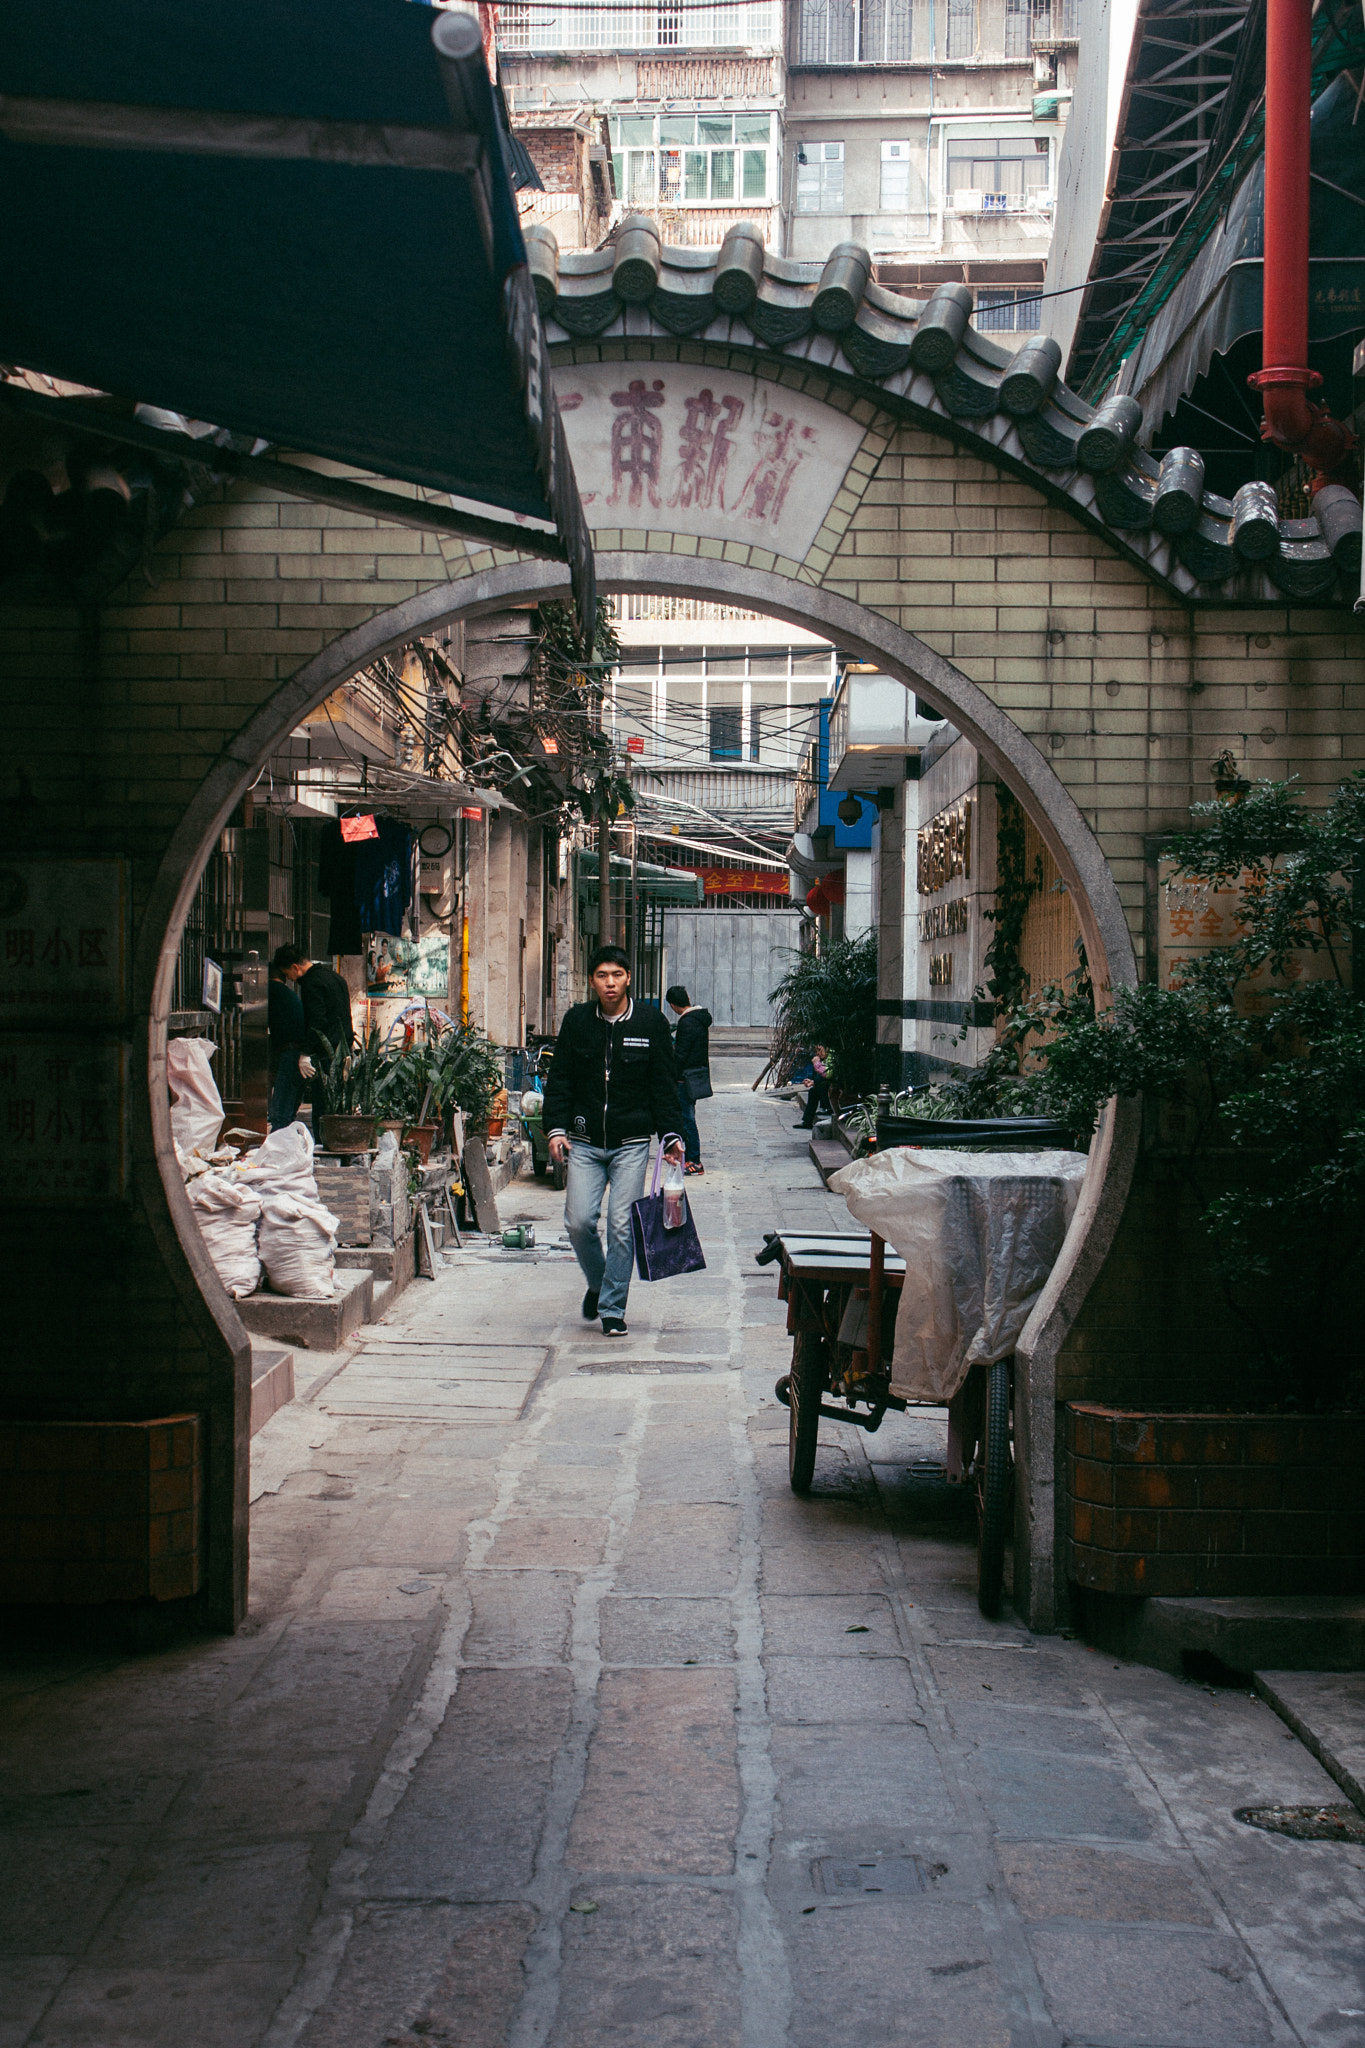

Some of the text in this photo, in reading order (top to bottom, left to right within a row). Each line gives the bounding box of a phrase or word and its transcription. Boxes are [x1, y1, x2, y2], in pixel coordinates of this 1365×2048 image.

[555, 380, 814, 525] 甫新街
[696, 872, 790, 891] 全至上,
[5, 929, 108, 968] 明小区
[575, 1116, 586, 1134] S
